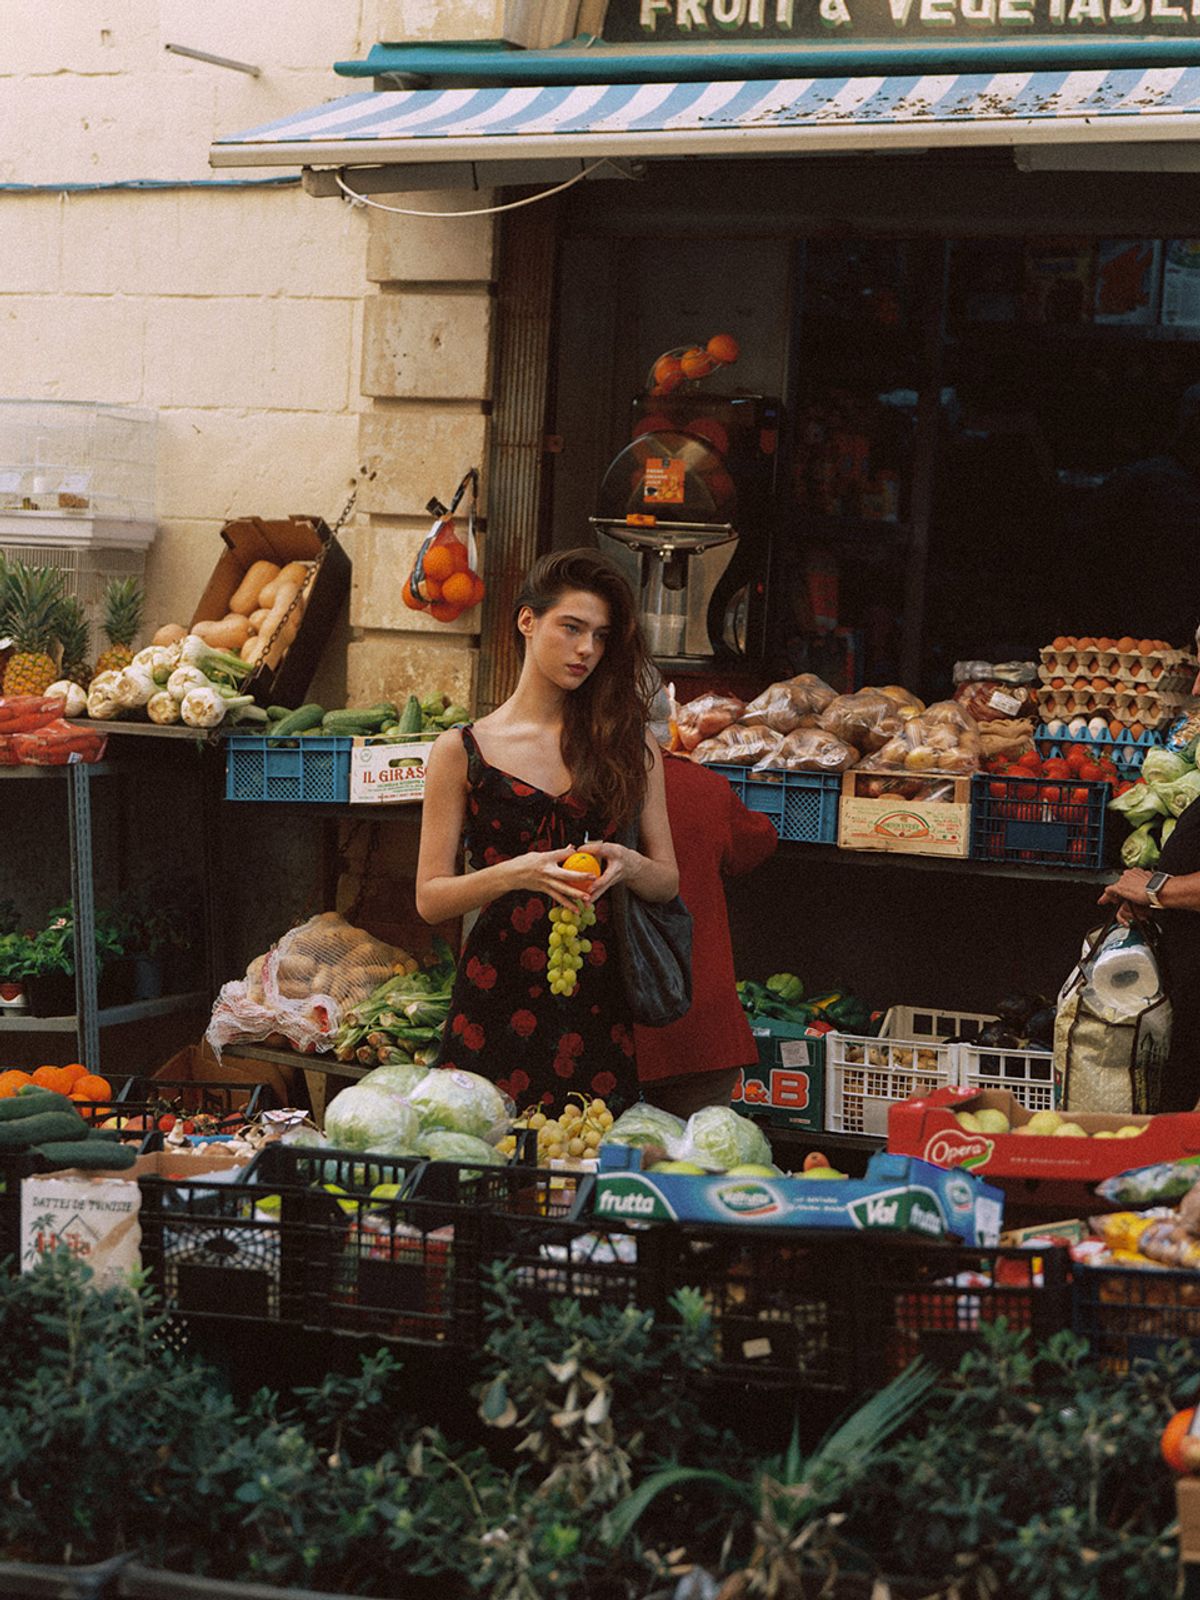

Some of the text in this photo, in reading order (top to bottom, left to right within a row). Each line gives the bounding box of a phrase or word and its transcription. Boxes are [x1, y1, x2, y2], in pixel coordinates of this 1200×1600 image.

[363, 766, 428, 783] IL GIRAS
[931, 1140, 982, 1163] Opera
[598, 1189, 655, 1214] frutta
[866, 1198, 899, 1225] Val
